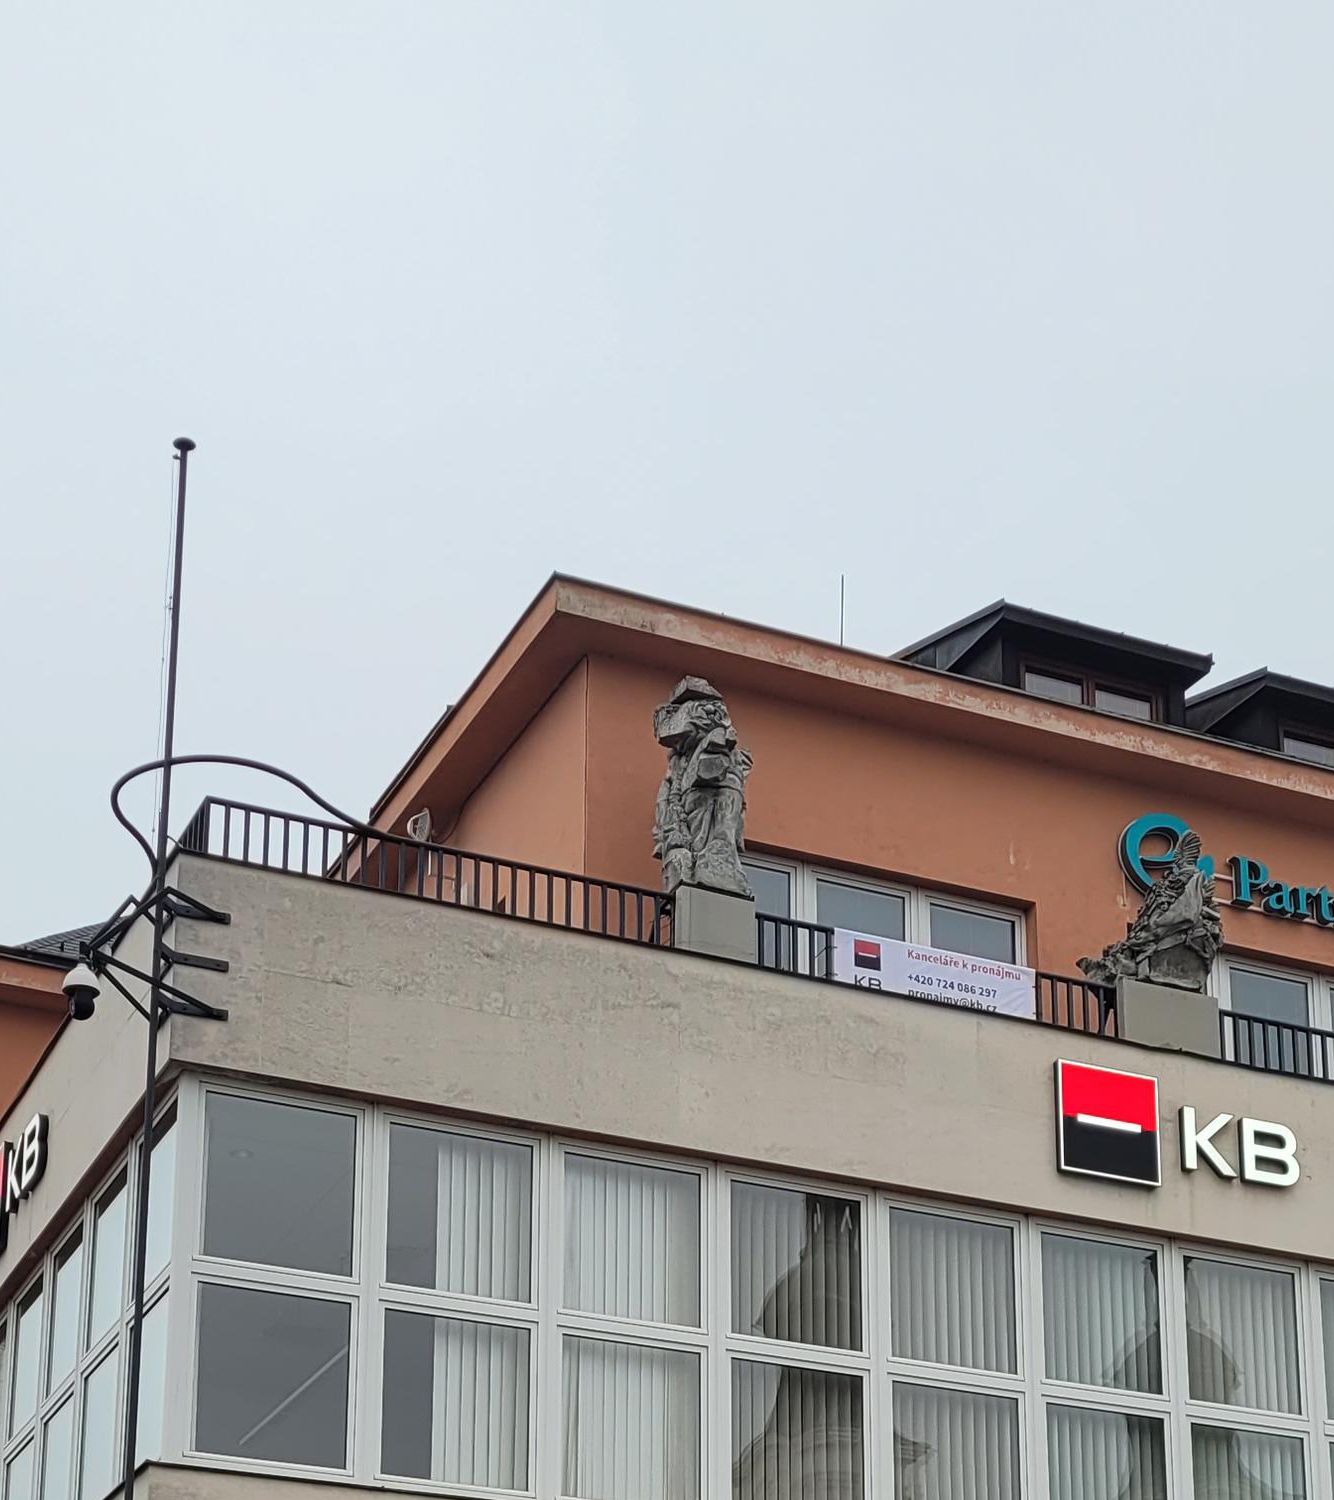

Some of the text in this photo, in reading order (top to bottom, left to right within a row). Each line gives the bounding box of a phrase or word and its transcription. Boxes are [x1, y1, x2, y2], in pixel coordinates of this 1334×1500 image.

[907, 949, 1021, 981] Kanceláře k pronájmu
[907, 974, 997, 999] +420 724 086 297
[5, 1113, 48, 1214] KB
[1178, 1104, 1301, 1188] KB
